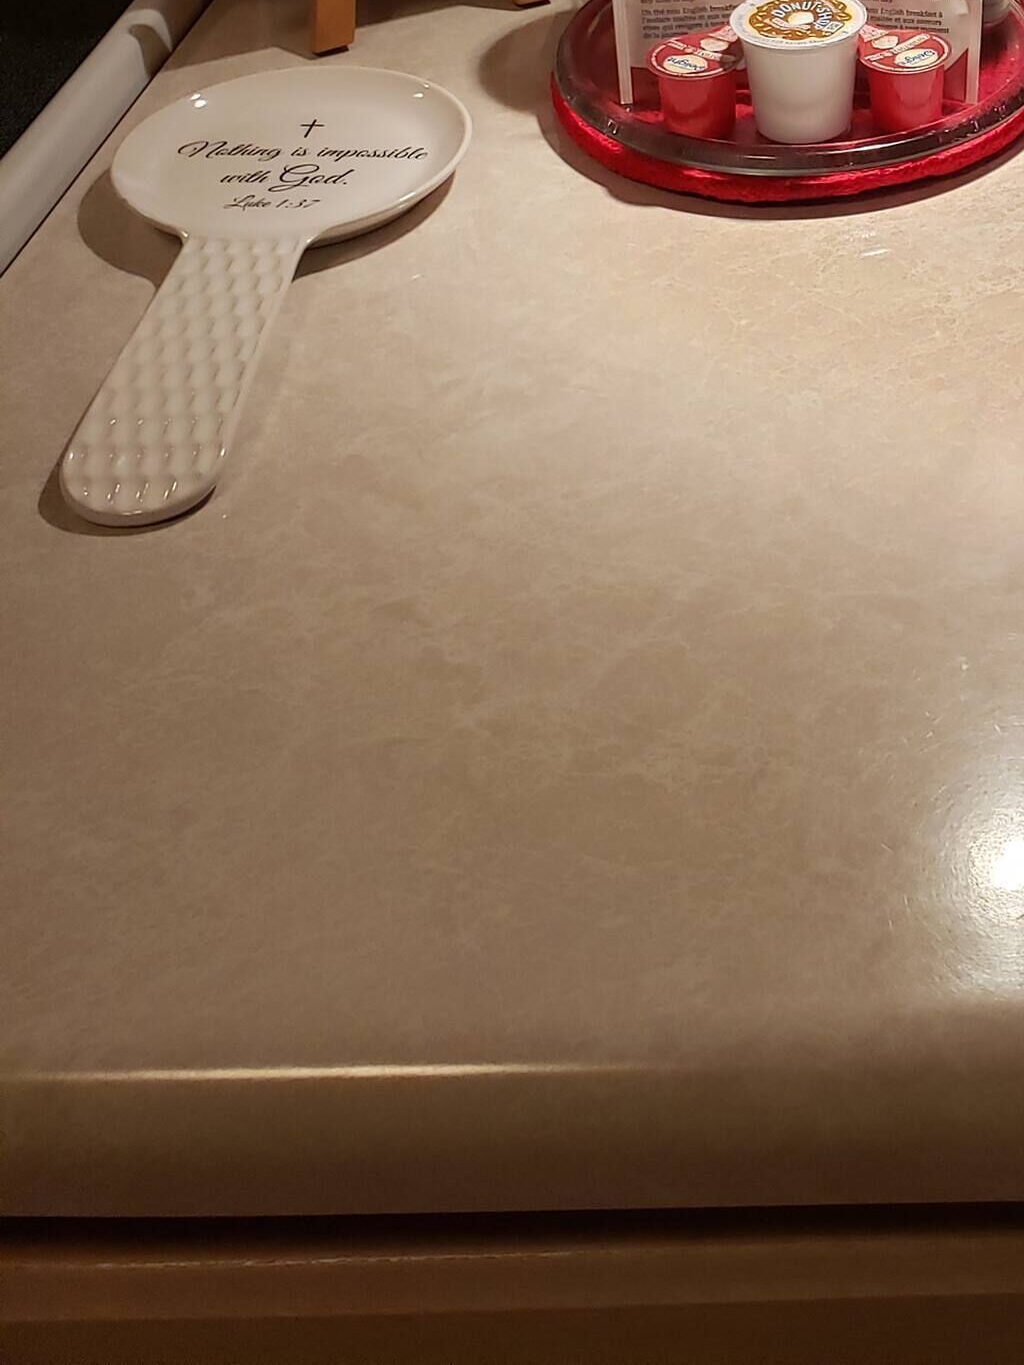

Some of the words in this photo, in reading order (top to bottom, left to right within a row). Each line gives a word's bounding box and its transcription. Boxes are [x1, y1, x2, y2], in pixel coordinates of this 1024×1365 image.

[177, 140, 283, 162] Nothing
[291, 146, 309, 158] is
[316, 145, 430, 162] impossible
[219, 170, 272, 185] with
[267, 163, 355, 193] God.
